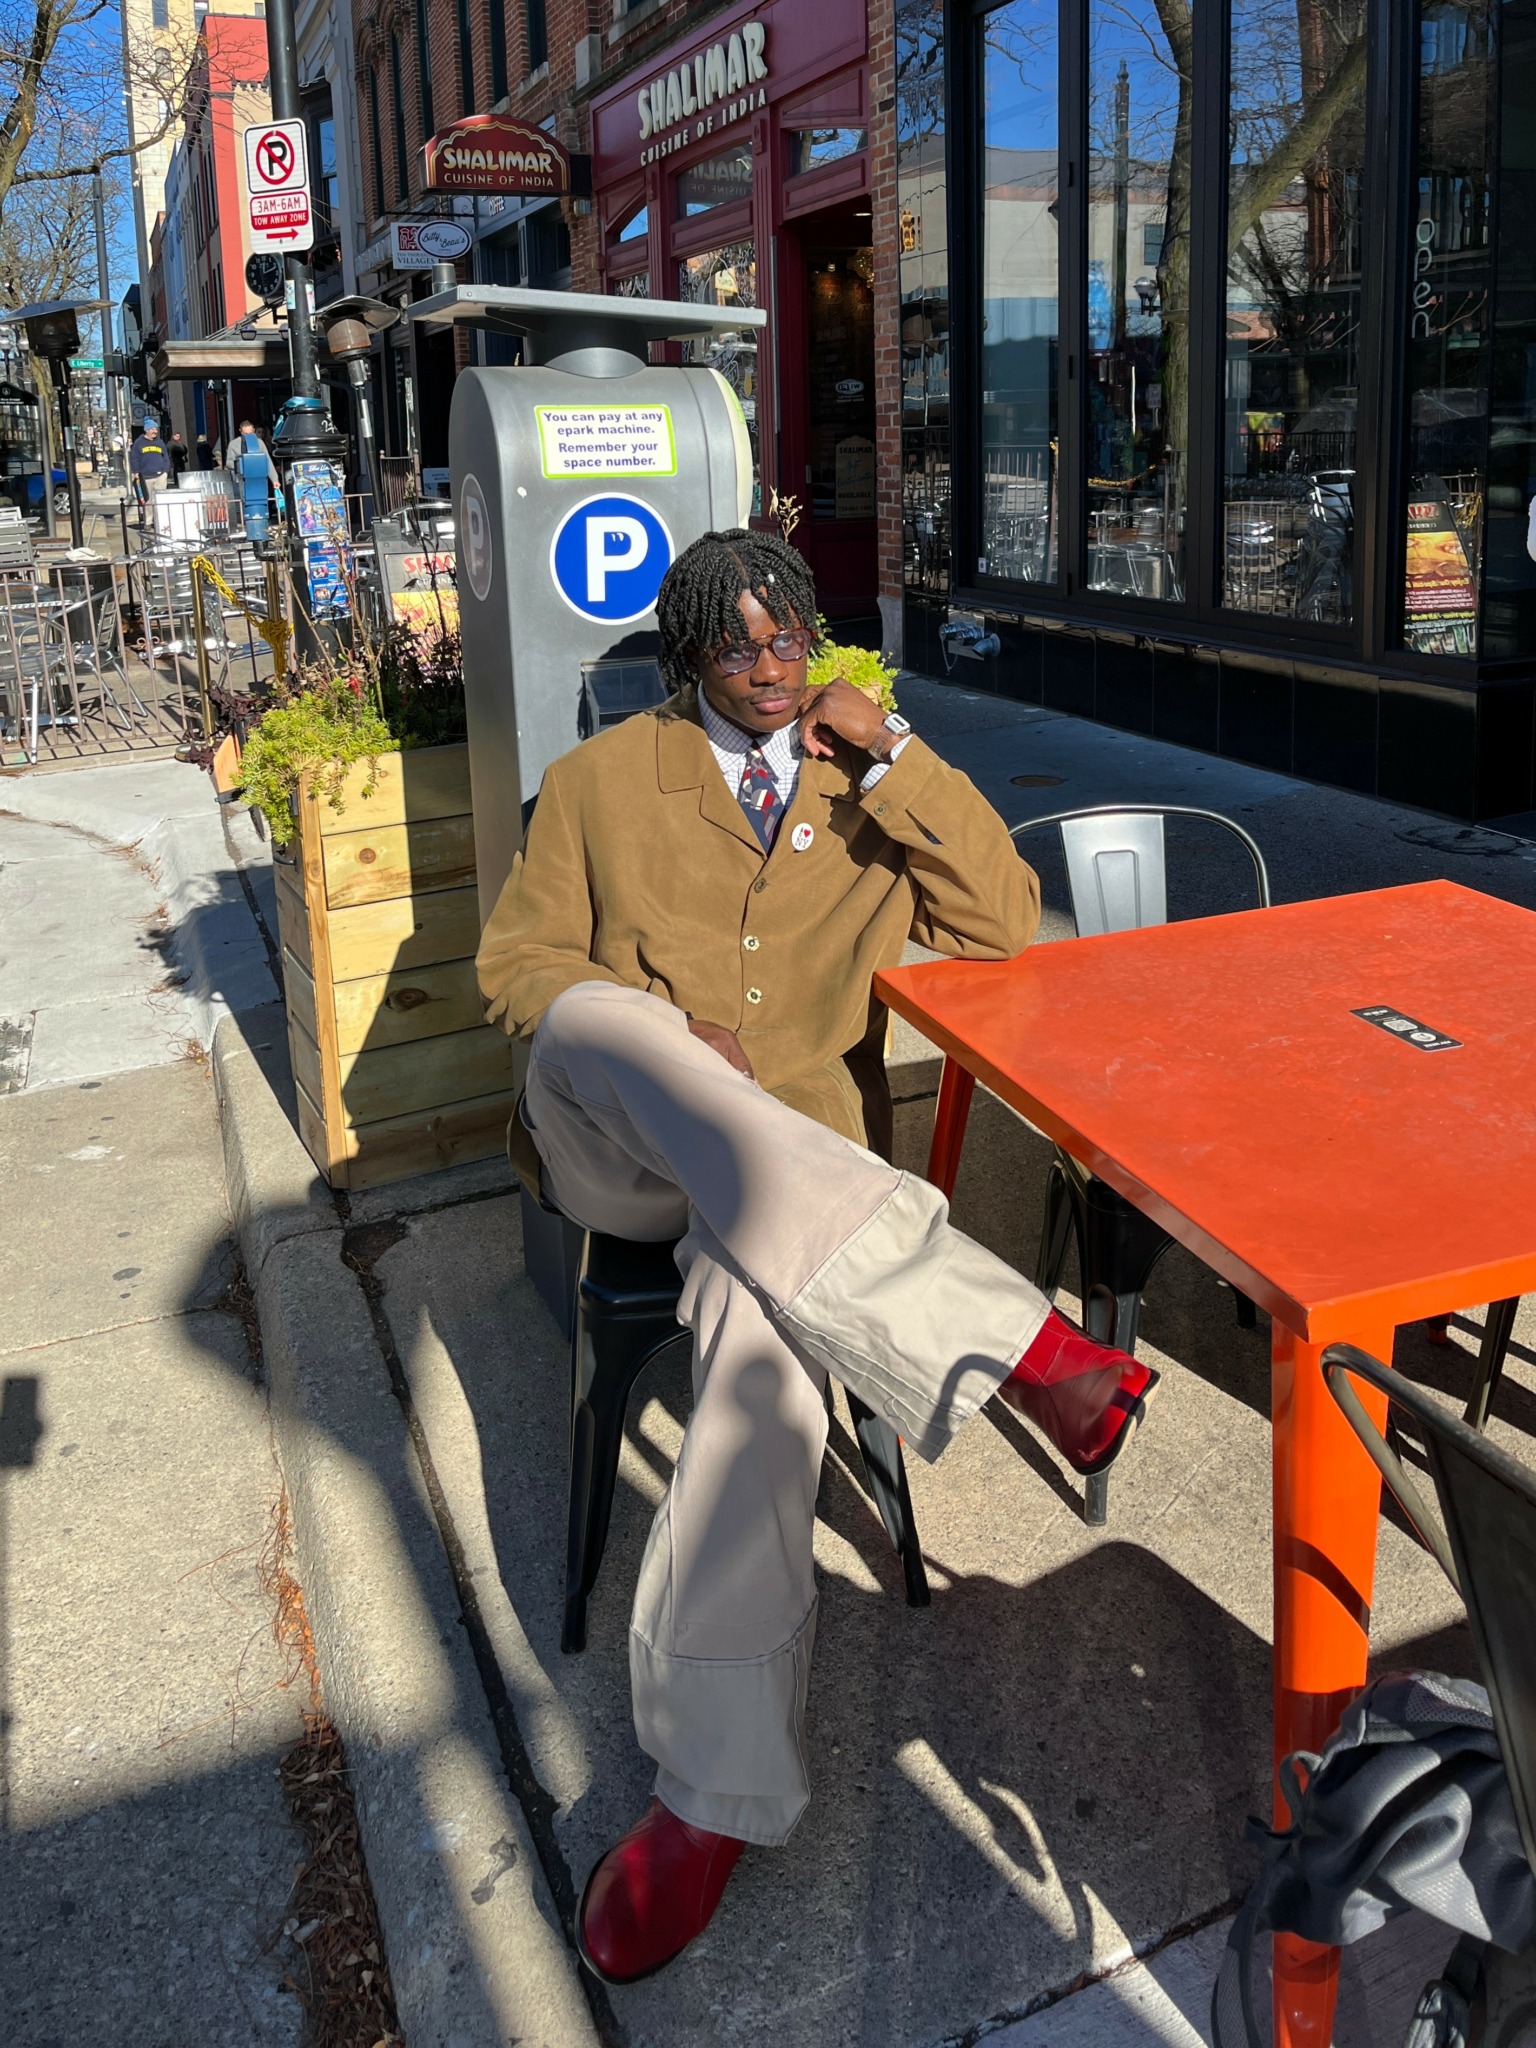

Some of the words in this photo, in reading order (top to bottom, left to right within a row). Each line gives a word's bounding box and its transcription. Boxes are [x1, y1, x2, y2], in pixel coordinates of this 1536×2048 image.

[638, 22, 768, 140] SHALIMAR
[640, 129, 689, 167] CUISINE
[697, 116, 713, 138] OF
[722, 88, 766, 126] INDIA
[443, 148, 553, 173] SHALIMAR
[444, 173, 493, 184] CUISINE
[500, 175, 515, 185] OF
[521, 176, 554, 187] INDIA
[257, 196, 301, 213] 3AM-6AM
[254, 216, 269, 226] TOW
[270, 214, 288, 225] AWAY
[289, 212, 307, 222] ZONE
[440, 236, 466, 248] Beau's
[1411, 217, 1435, 339] open
[544, 412, 567, 421] You
[572, 413, 594, 421] can
[599, 412, 621, 423] pay
[625, 412, 637, 420] at
[641, 412, 662, 421] any
[557, 425, 594, 437] epark
[598, 424, 655, 434] machine.
[558, 442, 627, 453] Remember
[631, 442, 658, 453] your
[839, 446, 873, 454] SHALIMAR
[564, 458, 602, 470] space
[606, 456, 656, 467] number.
[838, 491, 872, 499] AVAILABLE
[466, 495, 484, 577] P
[586, 516, 648, 602] P
[795, 837, 809, 848] NY
